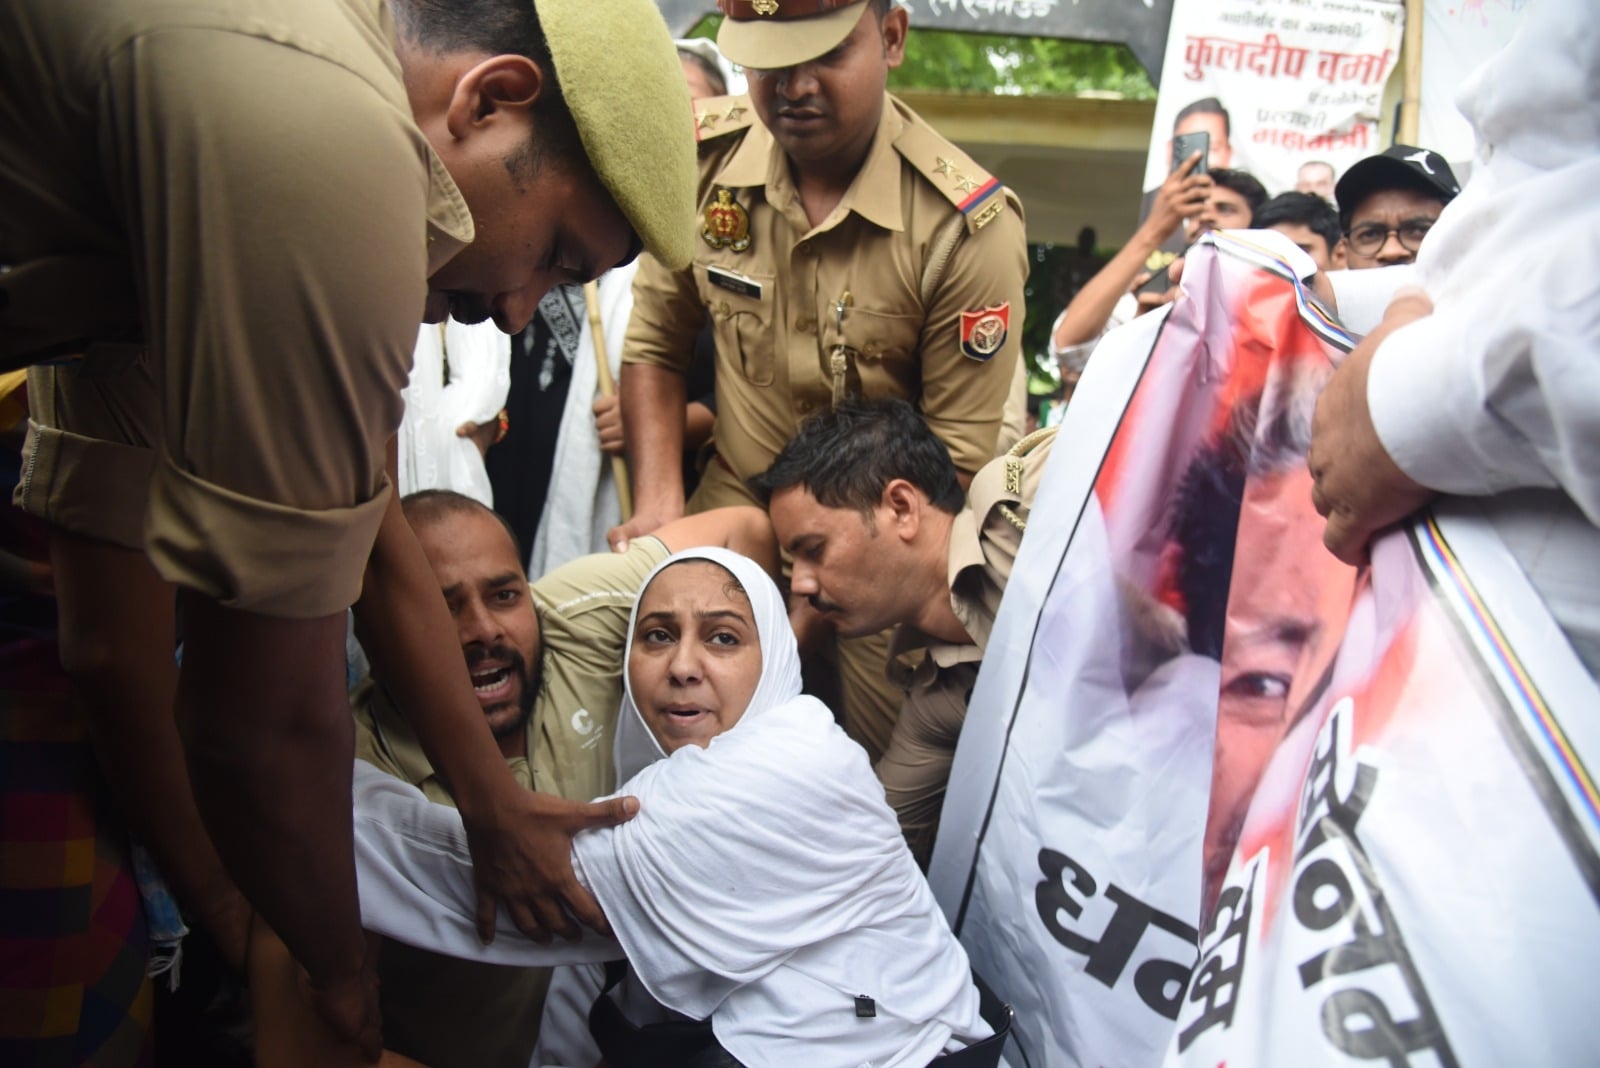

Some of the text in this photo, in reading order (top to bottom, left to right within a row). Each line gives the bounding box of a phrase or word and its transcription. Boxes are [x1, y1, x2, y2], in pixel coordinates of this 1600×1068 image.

[1184, 33, 1393, 85] कुलदीप वर्मा
[1252, 122, 1370, 152] महामंत्री
